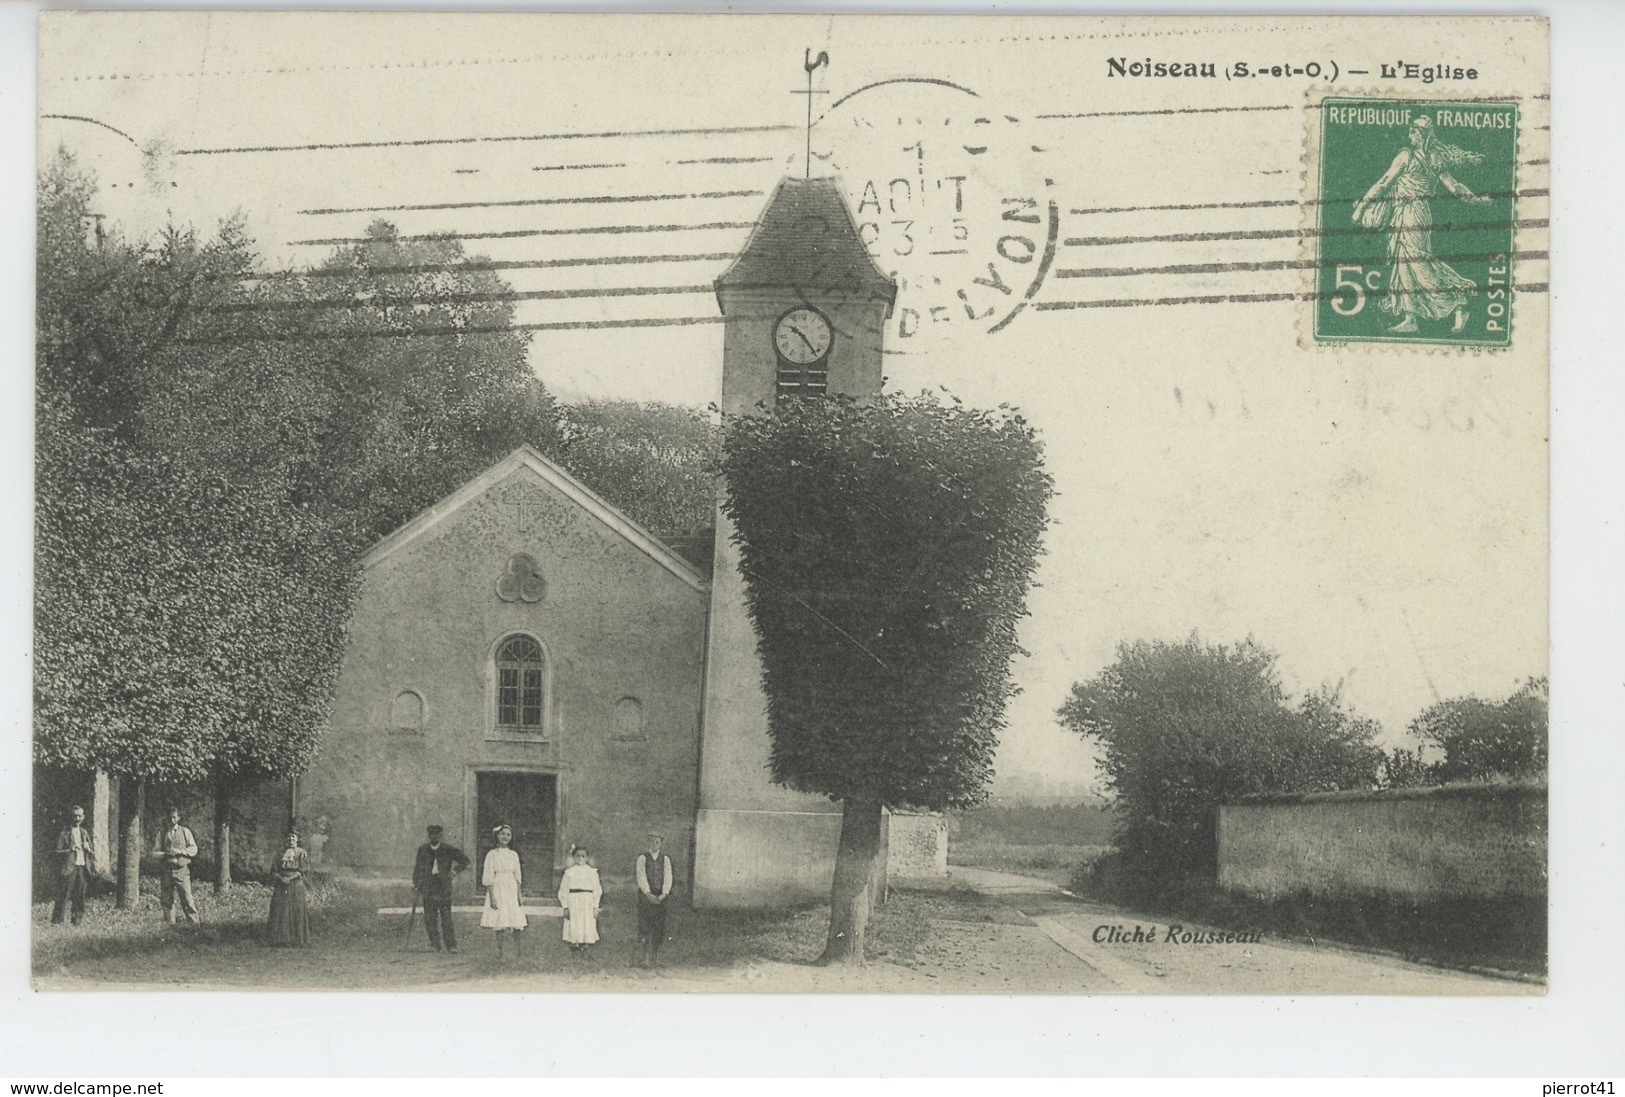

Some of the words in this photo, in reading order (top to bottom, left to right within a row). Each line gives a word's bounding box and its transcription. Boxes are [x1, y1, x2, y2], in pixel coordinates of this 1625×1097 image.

[1106, 56, 1217, 78] Noiseau
[1225, 60, 1340, 84] (S.-et-O.)
[1380, 60, 1480, 84] L'Eglise
[1436, 110, 1513, 130] FRANÇAISE
[957, 197, 1041, 321] LYON
[1486, 253, 1508, 332] POSTES
[1092, 924, 1156, 944] Cliché
[1164, 924, 1263, 946] Rousseau
